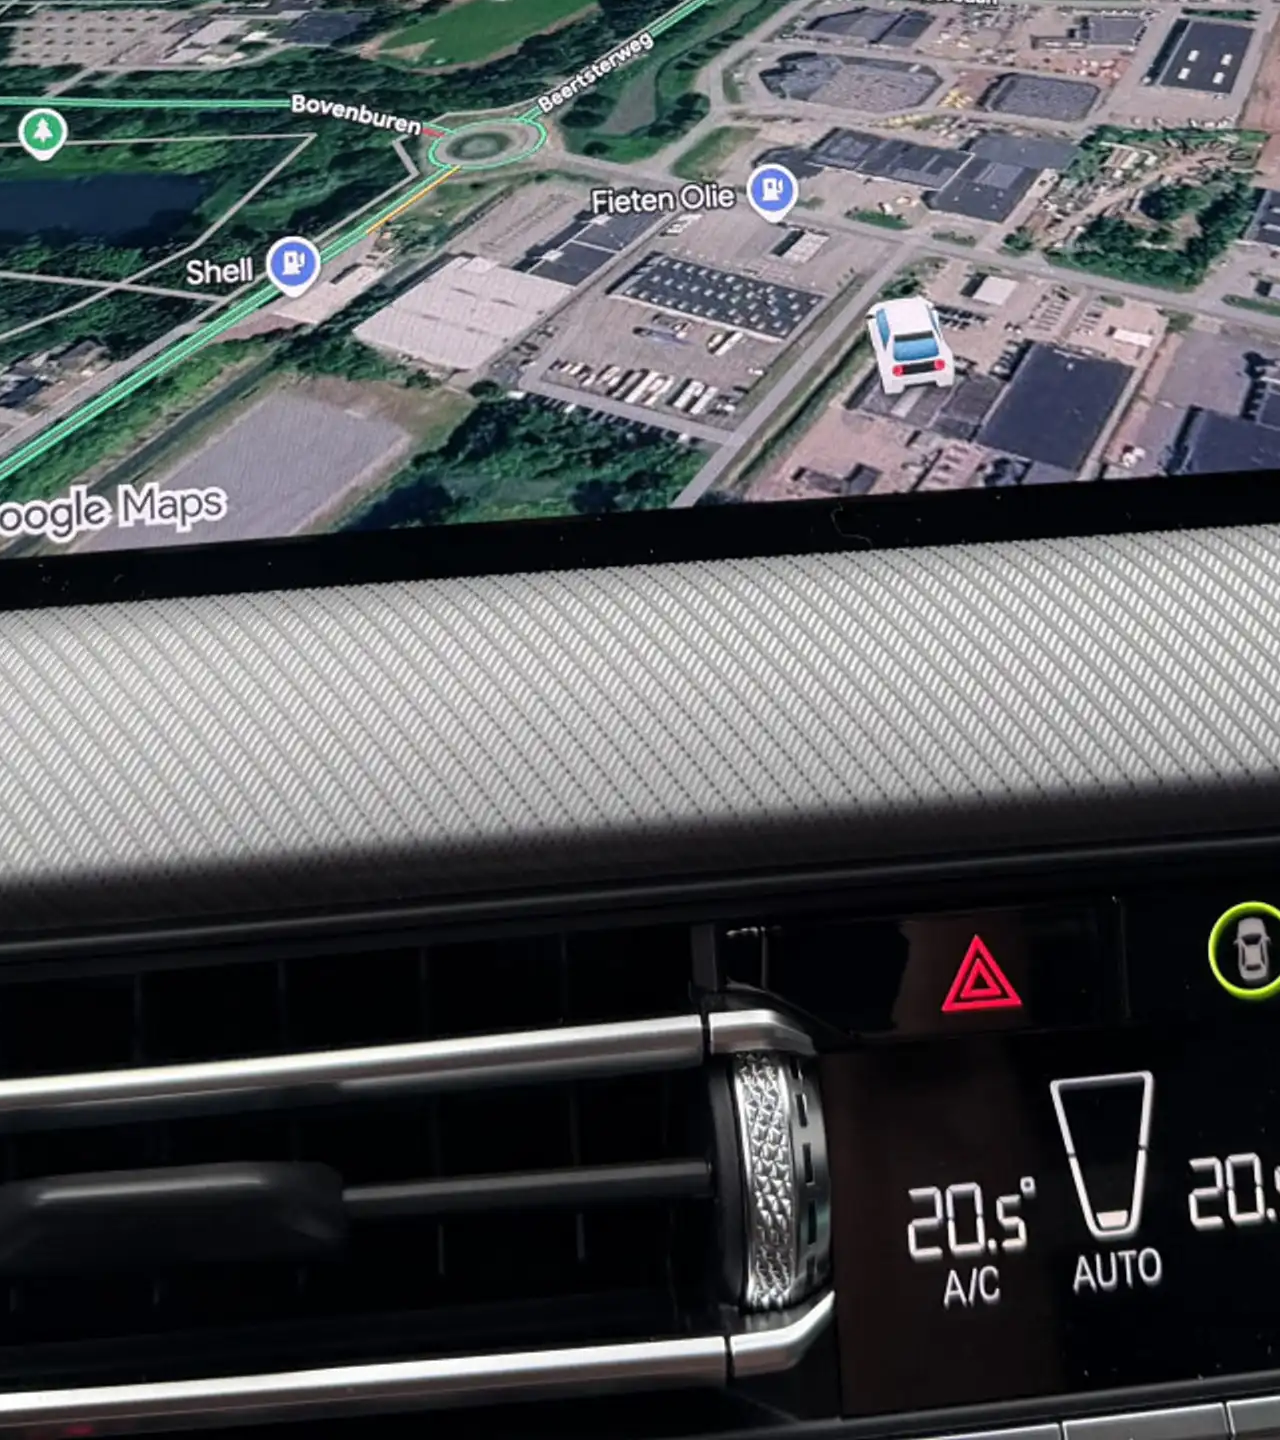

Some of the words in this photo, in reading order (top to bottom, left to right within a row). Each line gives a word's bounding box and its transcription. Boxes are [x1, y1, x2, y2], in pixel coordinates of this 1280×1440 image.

[538, 32, 654, 112] Beertsterweg
[291, 95, 422, 135] Bovenburen
[592, 189, 673, 214] Fieten
[681, 184, 736, 209] Olie
[187, 258, 253, 285] Shell
[122, 487, 225, 531] Maps
[943, 1266, 1001, 1308] A/C
[1073, 1247, 1162, 1294] AUTO
